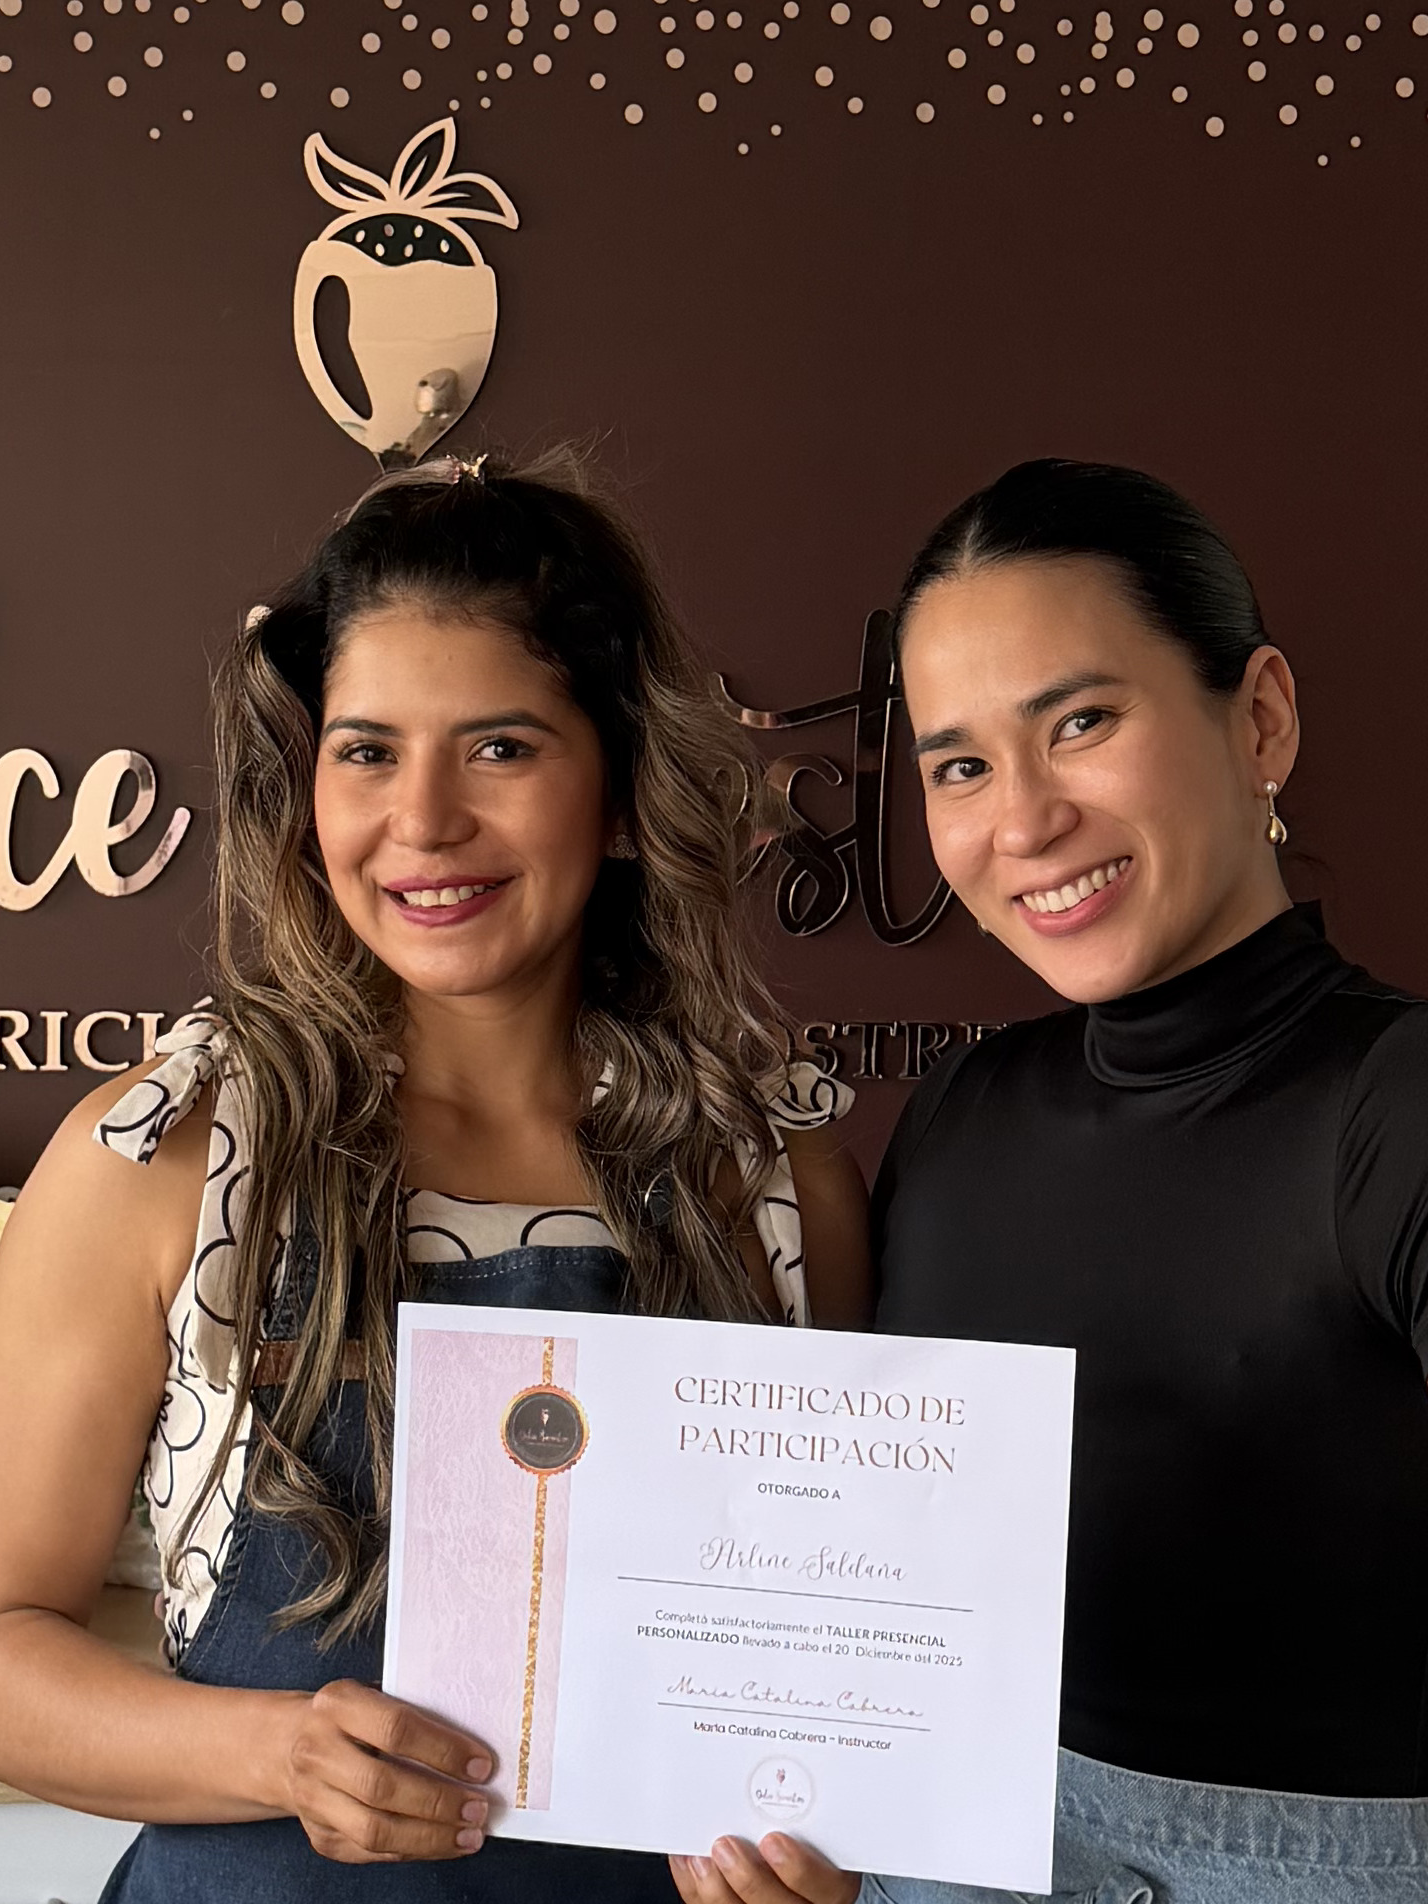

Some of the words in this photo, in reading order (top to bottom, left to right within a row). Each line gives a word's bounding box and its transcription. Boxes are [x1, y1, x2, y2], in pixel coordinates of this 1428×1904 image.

[674, 1376, 911, 1421] CERTIFICADO
[920, 1395, 965, 1426] DE
[679, 1424, 956, 1474] PARTICIPACIÓN
[757, 1482, 829, 1500] OTORGADO
[831, 1489, 841, 1500] A
[637, 1625, 740, 1645] PERSONALIZADO
[743, 1636, 781, 1649] llevado
[783, 1641, 790, 1649] a
[793, 1641, 819, 1653] cabo
[822, 1644, 832, 1653] el
[835, 1644, 850, 1656] 20
[855, 1646, 912, 1662] Diciembre
[711, 1616, 810, 1634] satisfactoriamente
[813, 1625, 823, 1635] el
[826, 1625, 870, 1640] TALLER
[872, 1630, 947, 1648] PRESENCIAL
[740, 1681, 832, 1708] Catalina
[837, 1690, 924, 1717] Cabrera
[728, 1724, 777, 1739] Catalina
[779, 1729, 826, 1744] Cabrera
[838, 1734, 892, 1750] Instructor
